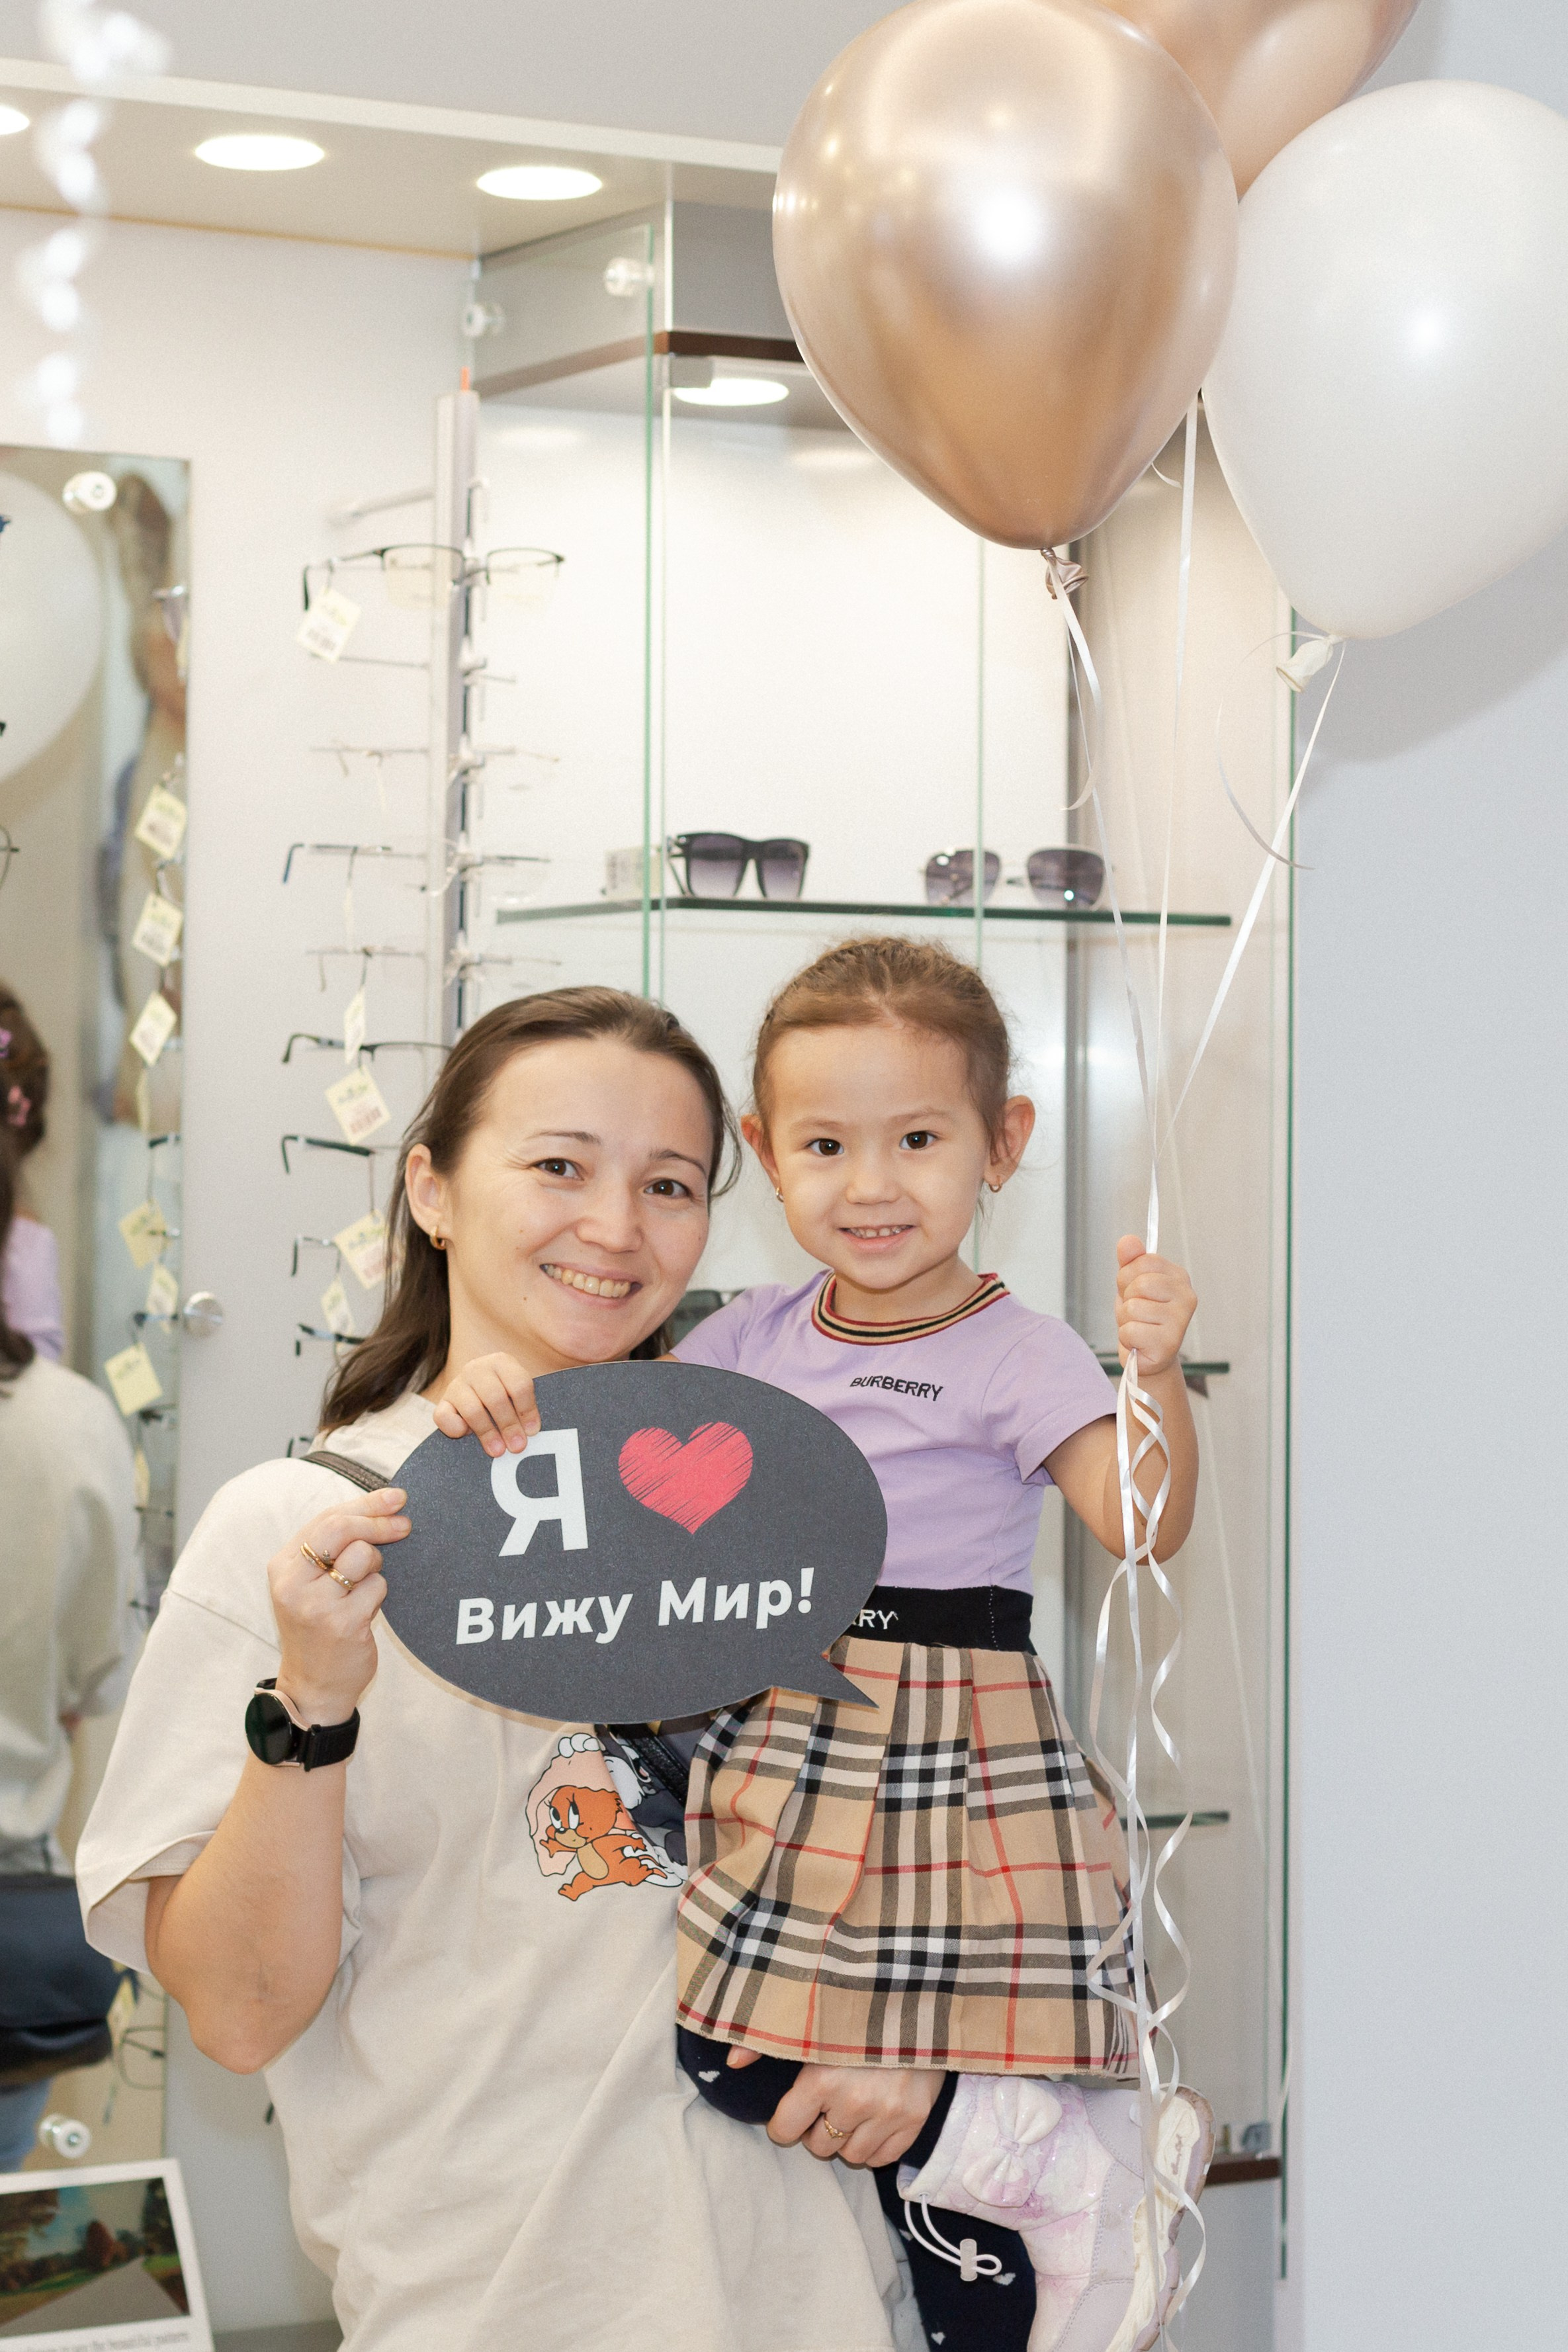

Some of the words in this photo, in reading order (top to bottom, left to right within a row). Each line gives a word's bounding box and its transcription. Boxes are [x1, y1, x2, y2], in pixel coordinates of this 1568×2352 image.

[849, 1375, 943, 1401] BURBERRY
[491, 1428, 588, 1557] Я
[456, 1593, 633, 1644] Вижу
[658, 1567, 814, 1630] Мир!
[852, 1609, 896, 1630] RY
